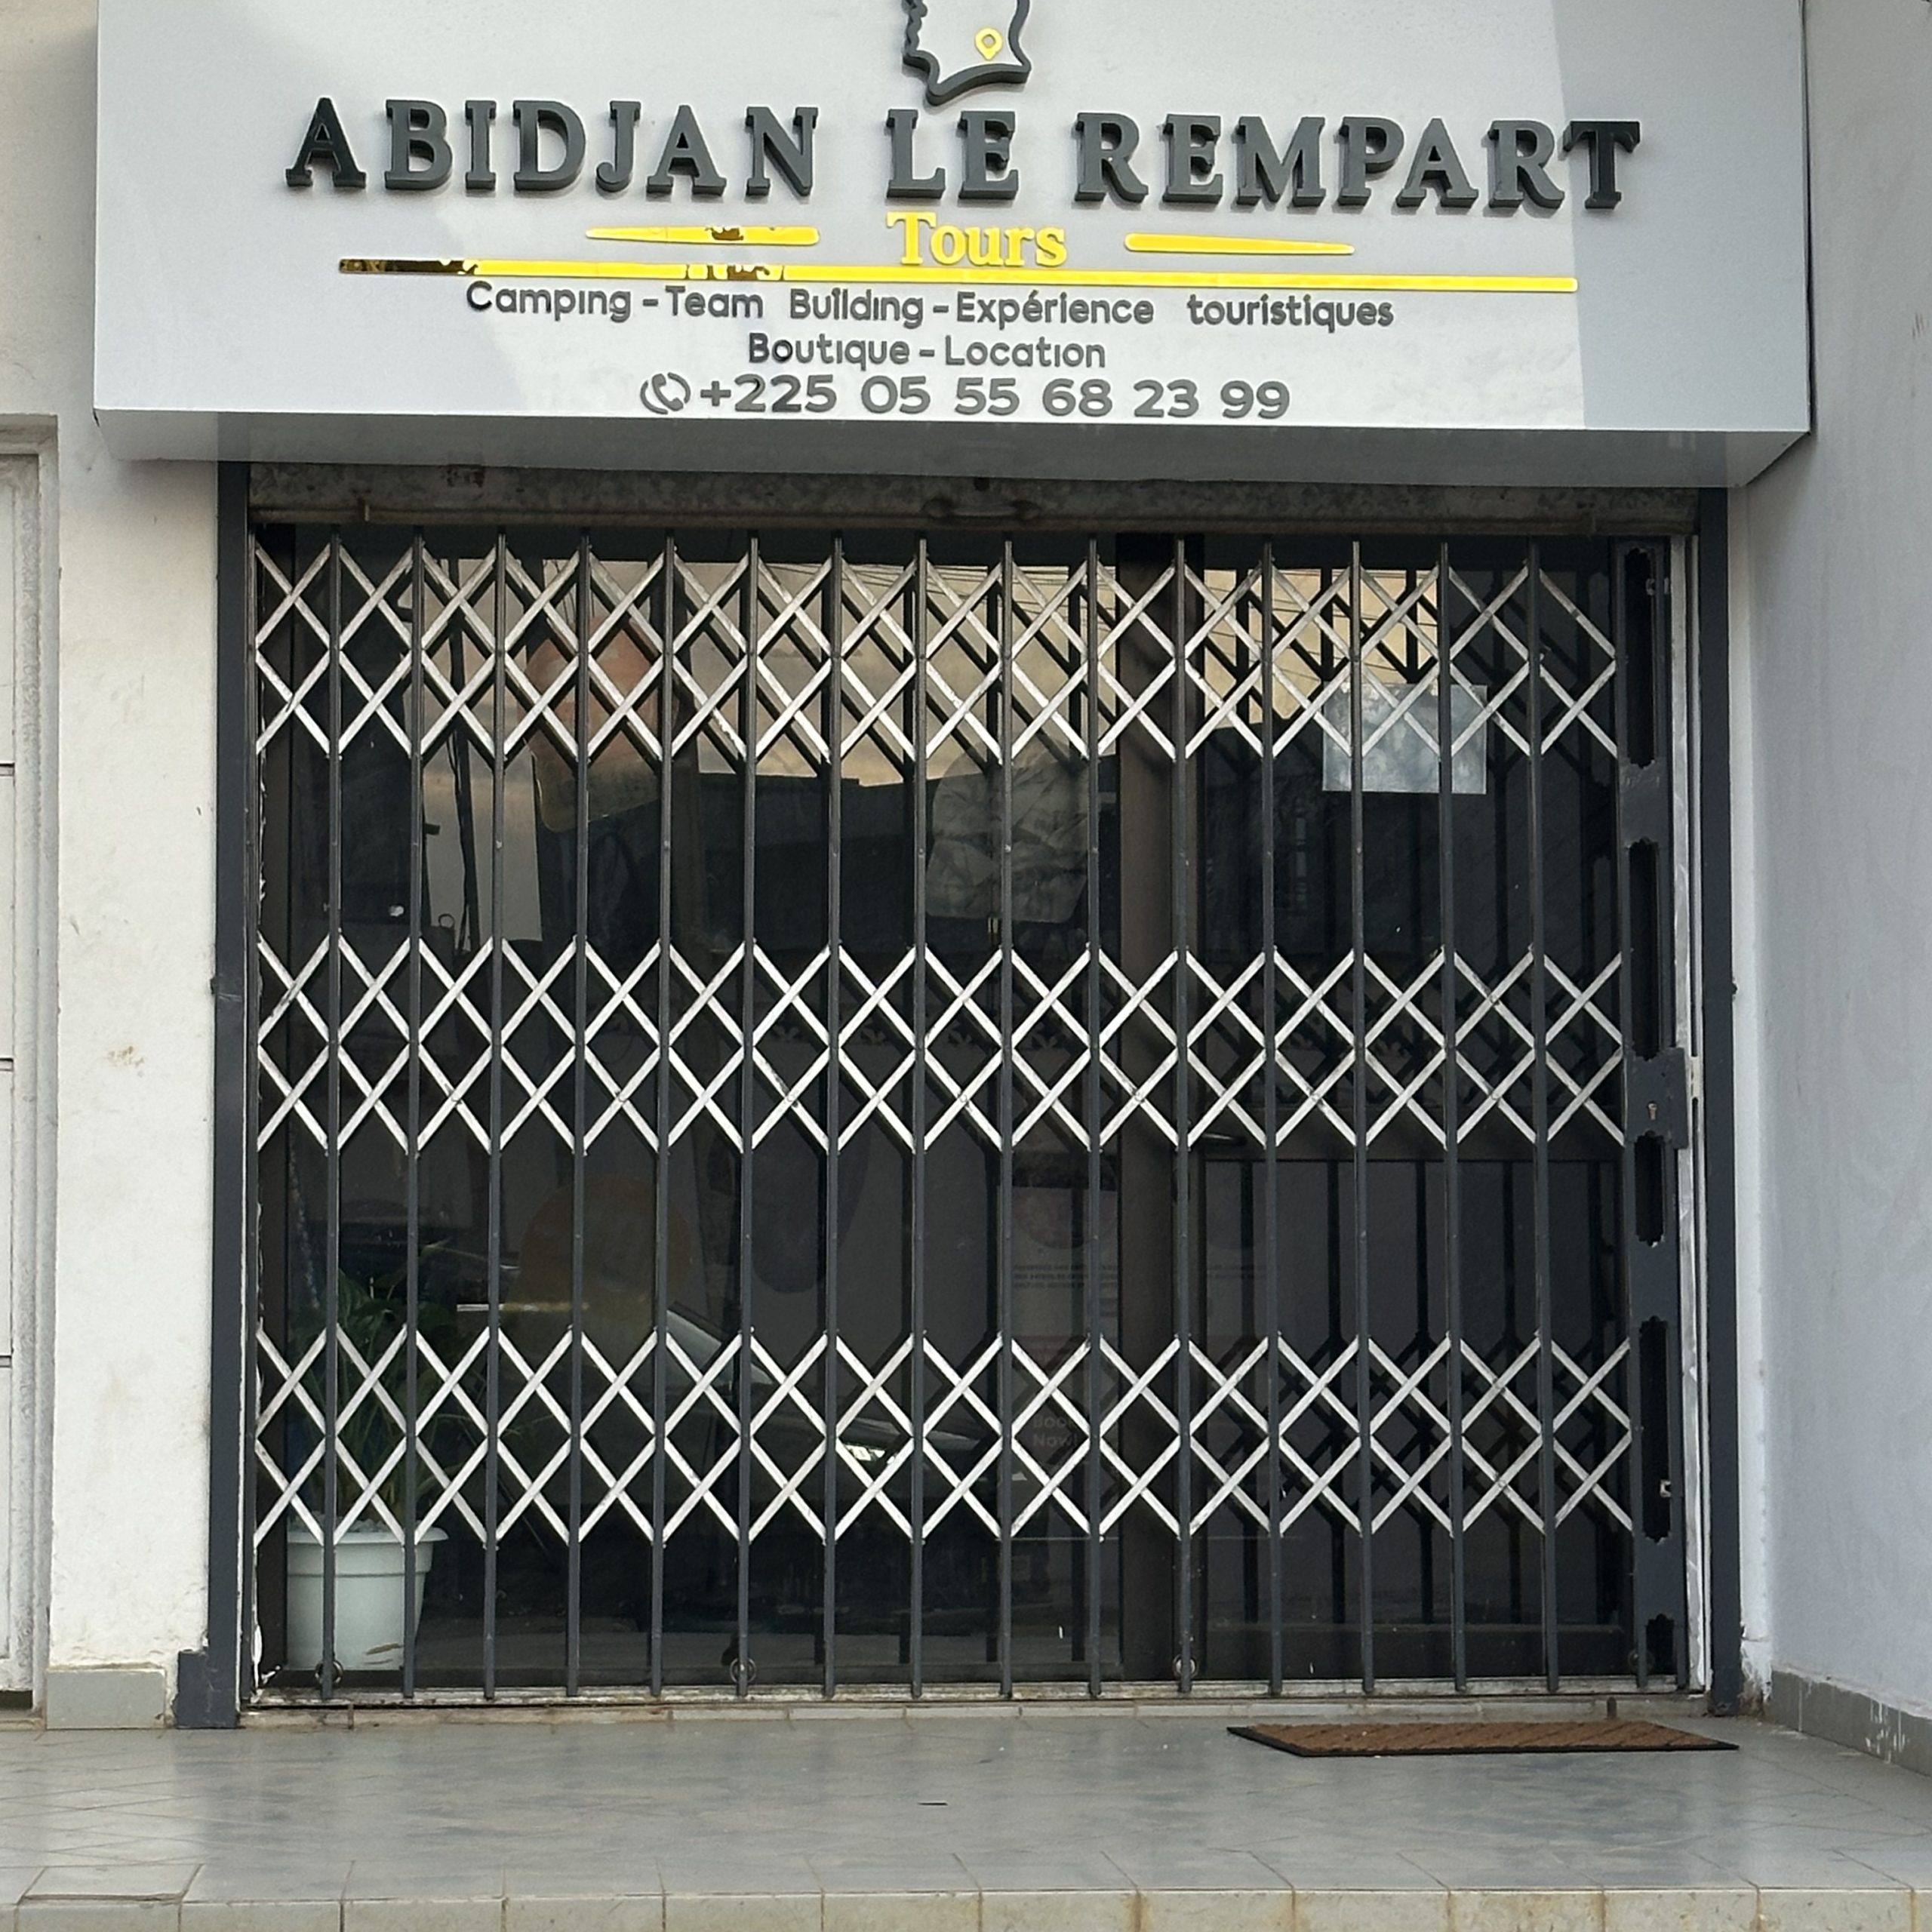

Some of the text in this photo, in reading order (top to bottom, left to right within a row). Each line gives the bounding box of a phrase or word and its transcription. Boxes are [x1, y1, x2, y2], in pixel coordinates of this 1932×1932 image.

[285, 97, 1641, 209] ABIDJAN LE REMPART
[886, 210, 1067, 266] Tours
[466, 280, 632, 323] Camping
[789, 288, 924, 328] Building
[1187, 293, 1394, 334] touristiques
[749, 333, 910, 371] Boutique
[700, 373, 1290, 420] +225 05 55 68 23 99
